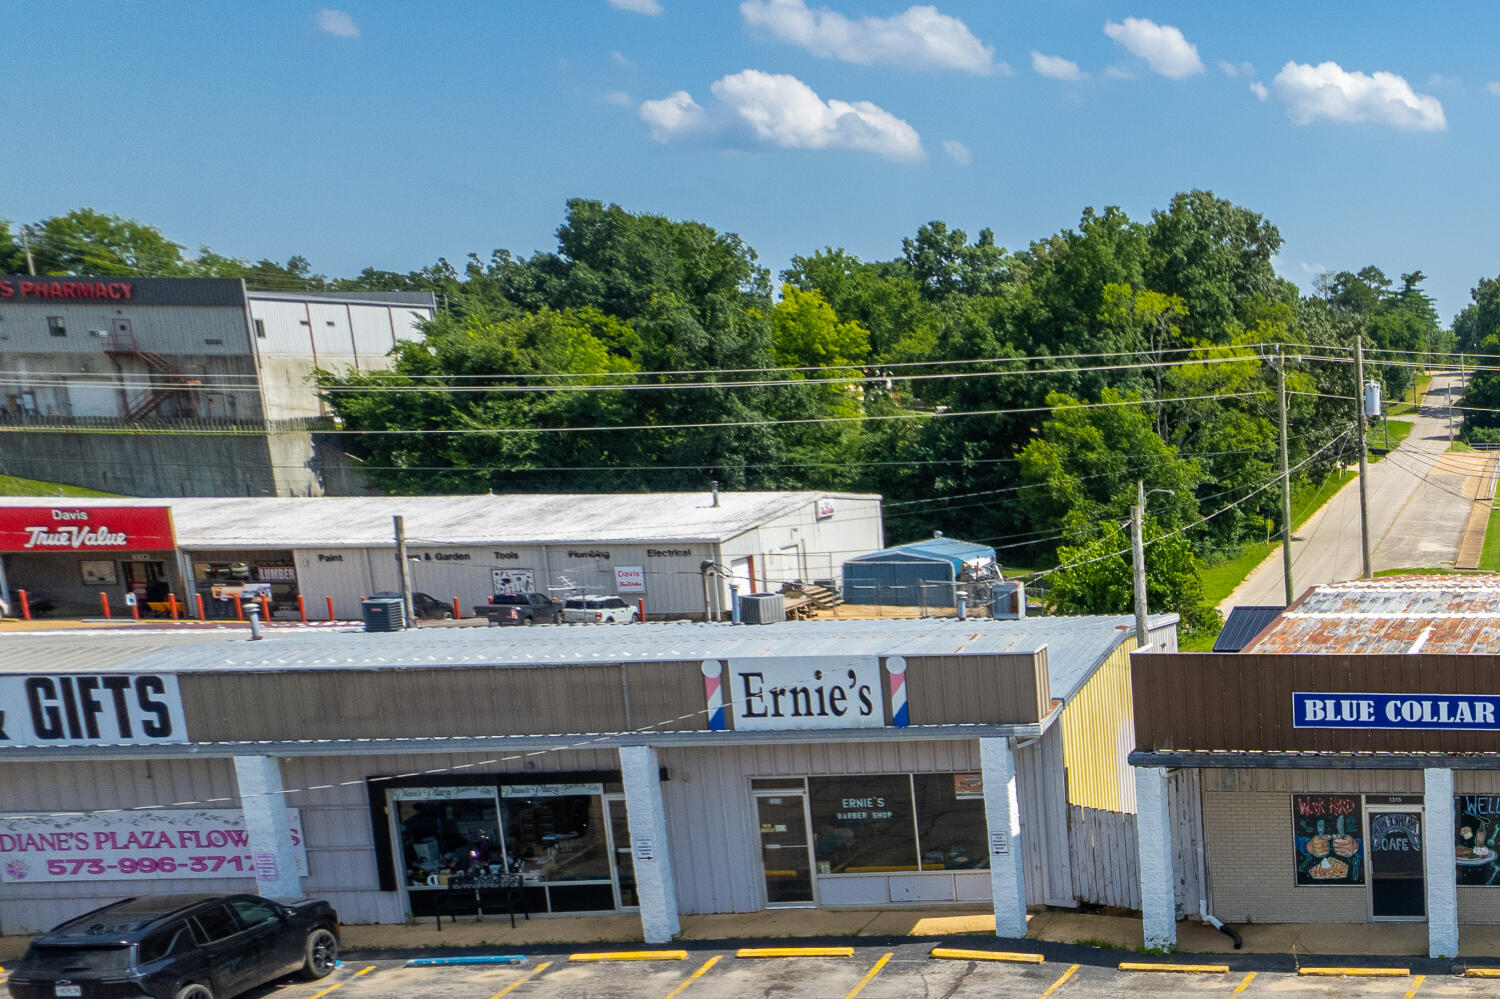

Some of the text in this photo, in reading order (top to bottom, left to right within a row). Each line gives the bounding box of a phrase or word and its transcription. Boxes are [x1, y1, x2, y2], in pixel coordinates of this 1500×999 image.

[20, 281, 132, 299] PHARMACY
[51, 509, 88, 520] Davis
[318, 554, 343, 562] Paint
[435, 552, 471, 561] Garden
[493, 551, 519, 560] Tools
[568, 550, 610, 560] Plumbing
[647, 549, 692, 558] Electrical
[260, 567, 295, 580] LUMBER
[617, 570, 640, 578] Davis
[738, 669, 873, 718] Ernie's
[26, 676, 172, 740] GIFTS
[1304, 699, 1376, 722] BLUE
[1385, 700, 1496, 724] COLLAR
[842, 796, 885, 808] ERNIE'S
[836, 811, 893, 820] BARBER SHOP
[0, 832, 88, 852] DIANE'S
[95, 831, 176, 851] PLAZA
